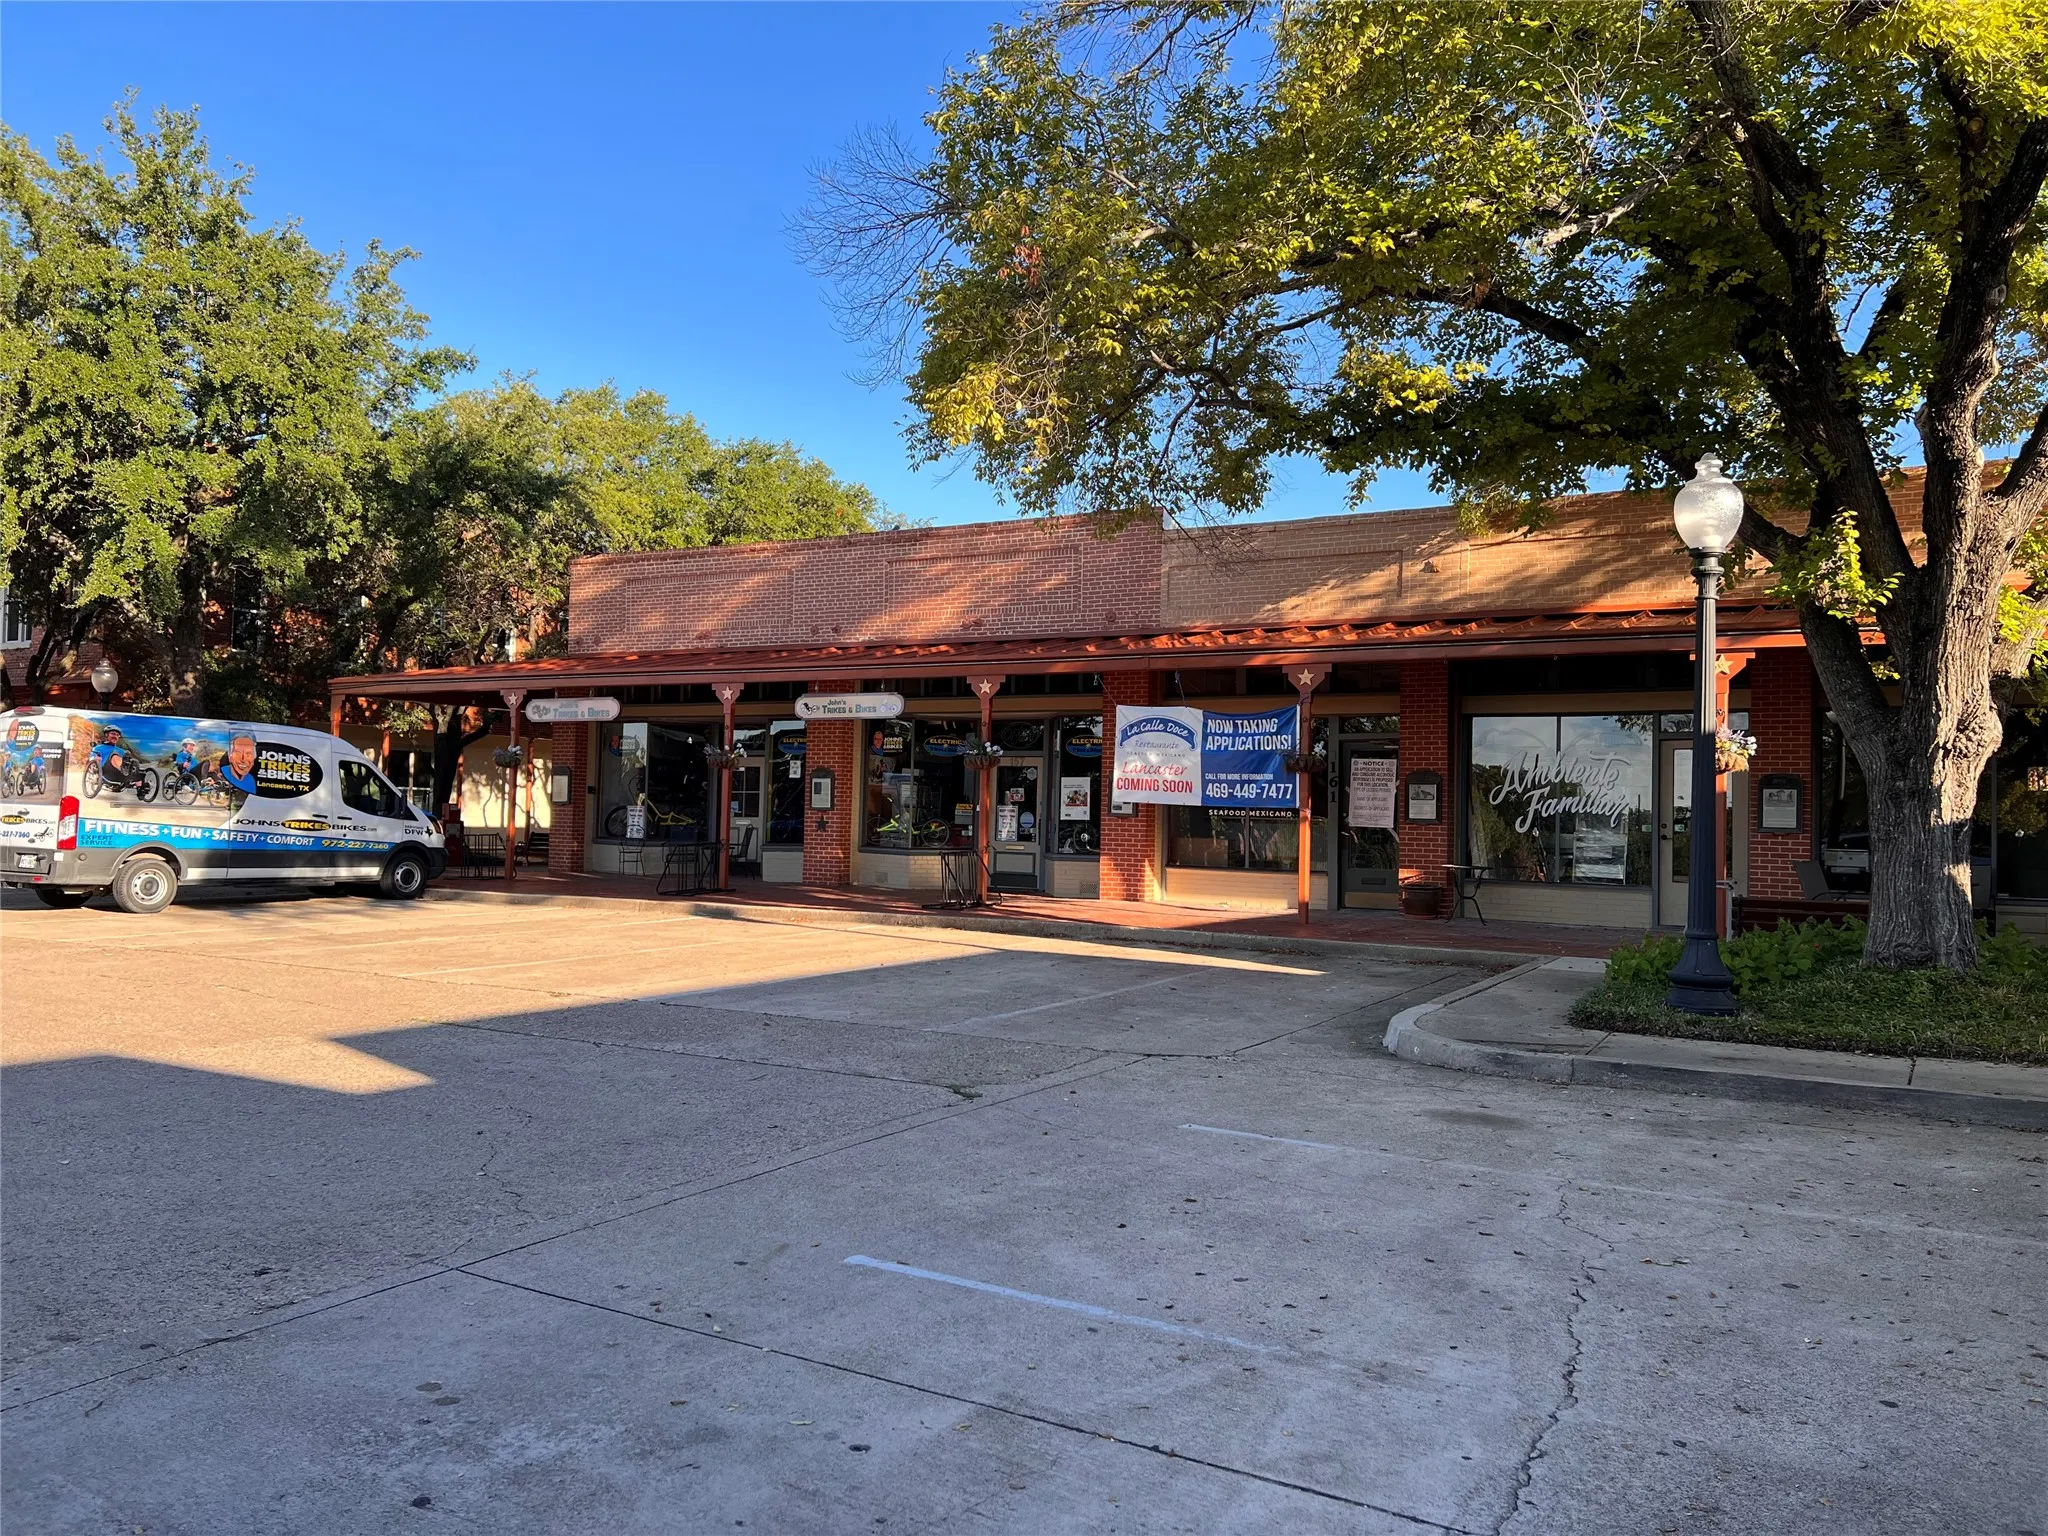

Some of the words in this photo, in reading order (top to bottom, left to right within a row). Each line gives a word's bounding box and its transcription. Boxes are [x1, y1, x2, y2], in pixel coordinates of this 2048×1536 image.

[588, 707, 610, 717] BIKES
[822, 705, 846, 714] TRIKES
[855, 704, 877, 713] BIKES
[1127, 727, 1140, 735] La
[1140, 720, 1165, 731] Calle
[1167, 723, 1189, 736] Doce
[1207, 719, 1234, 734] NOW
[1235, 718, 1278, 733] TAKING
[1136, 740, 1180, 749] Restaurante
[1205, 734, 1292, 750] APPLICATIONS!
[259, 760, 311, 774] TRIKES
[1123, 761, 1188, 776] Lancaster
[257, 781, 296, 790] Lancaster,
[1117, 777, 1160, 792] COMING
[1162, 779, 1193, 793] SOON
[1329, 761, 1339, 803] 161
[1489, 751, 1631, 805] Ambiente
[1206, 783, 1293, 799] 469-449-7477
[1515, 786, 1630, 833] Familiar
[85, 820, 159, 837] FITNESS
[171, 826, 200, 839] FUN
[212, 830, 259, 843] SAFETY
[267, 834, 314, 845] COMFORT
[322, 839, 388, 850] 972-227-7360
